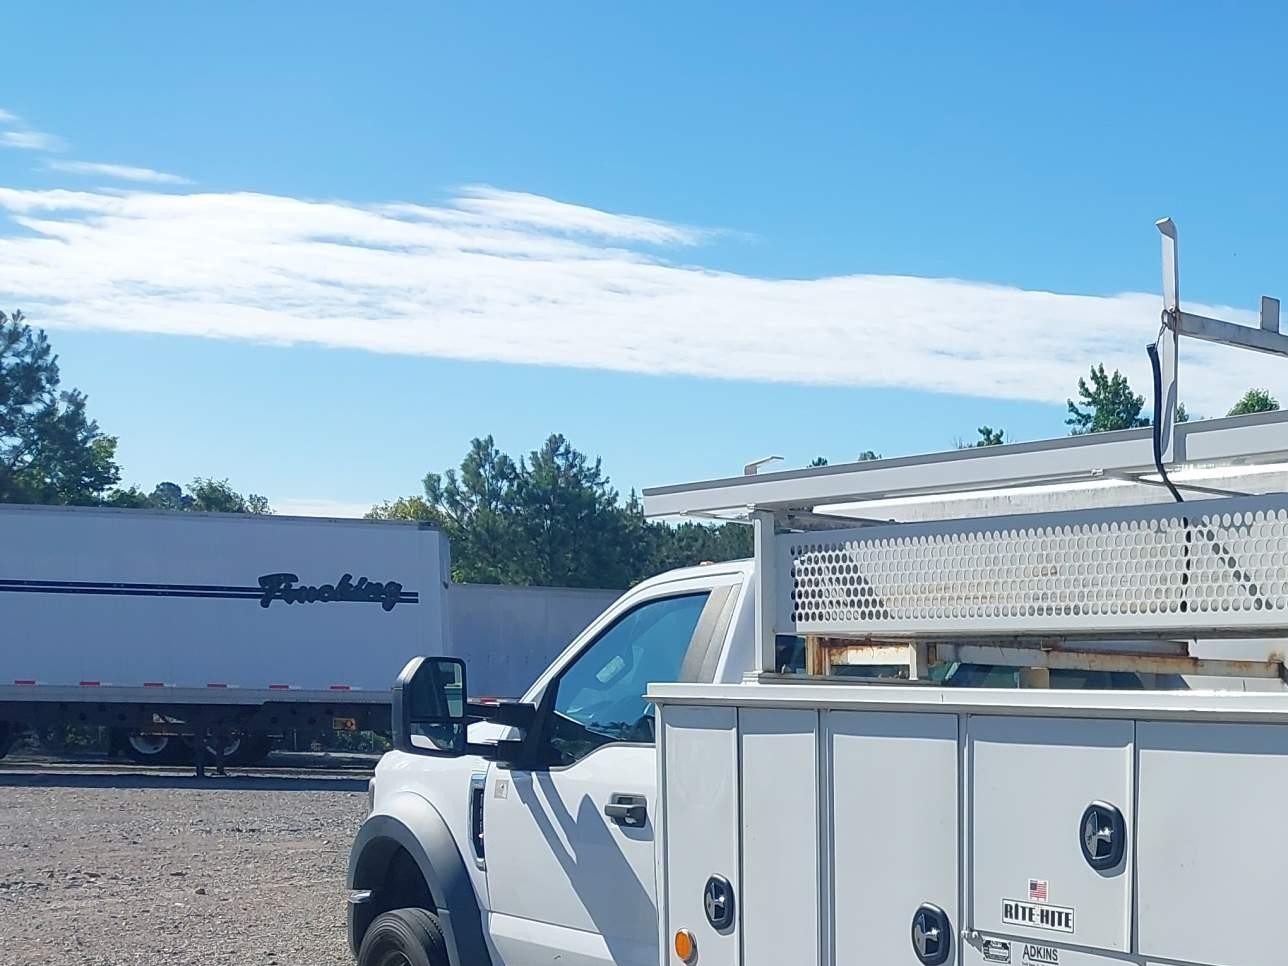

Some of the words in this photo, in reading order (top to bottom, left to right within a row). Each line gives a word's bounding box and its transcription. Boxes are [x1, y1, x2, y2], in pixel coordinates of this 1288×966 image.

[258, 573, 402, 611] Trucking
[1004, 903, 1072, 928] RITE-HITE
[1022, 943, 1059, 963] ADKINS
